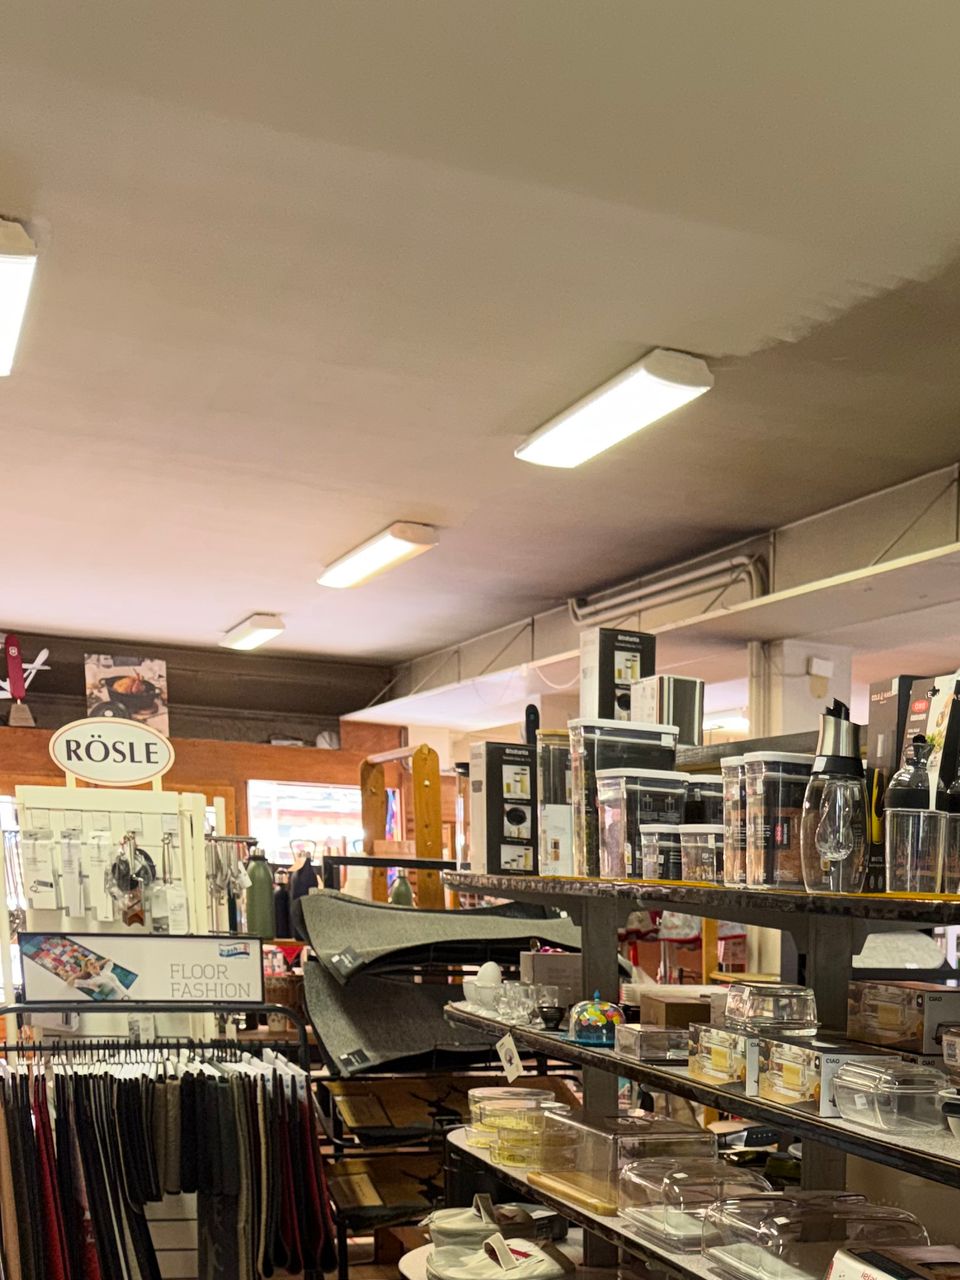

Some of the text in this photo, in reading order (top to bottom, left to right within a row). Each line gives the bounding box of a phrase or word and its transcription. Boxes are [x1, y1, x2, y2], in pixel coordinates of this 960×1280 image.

[65, 734, 159, 764] RÖSLE
[170, 963, 229, 980] FLOOR
[171, 982, 251, 999] FASHION
